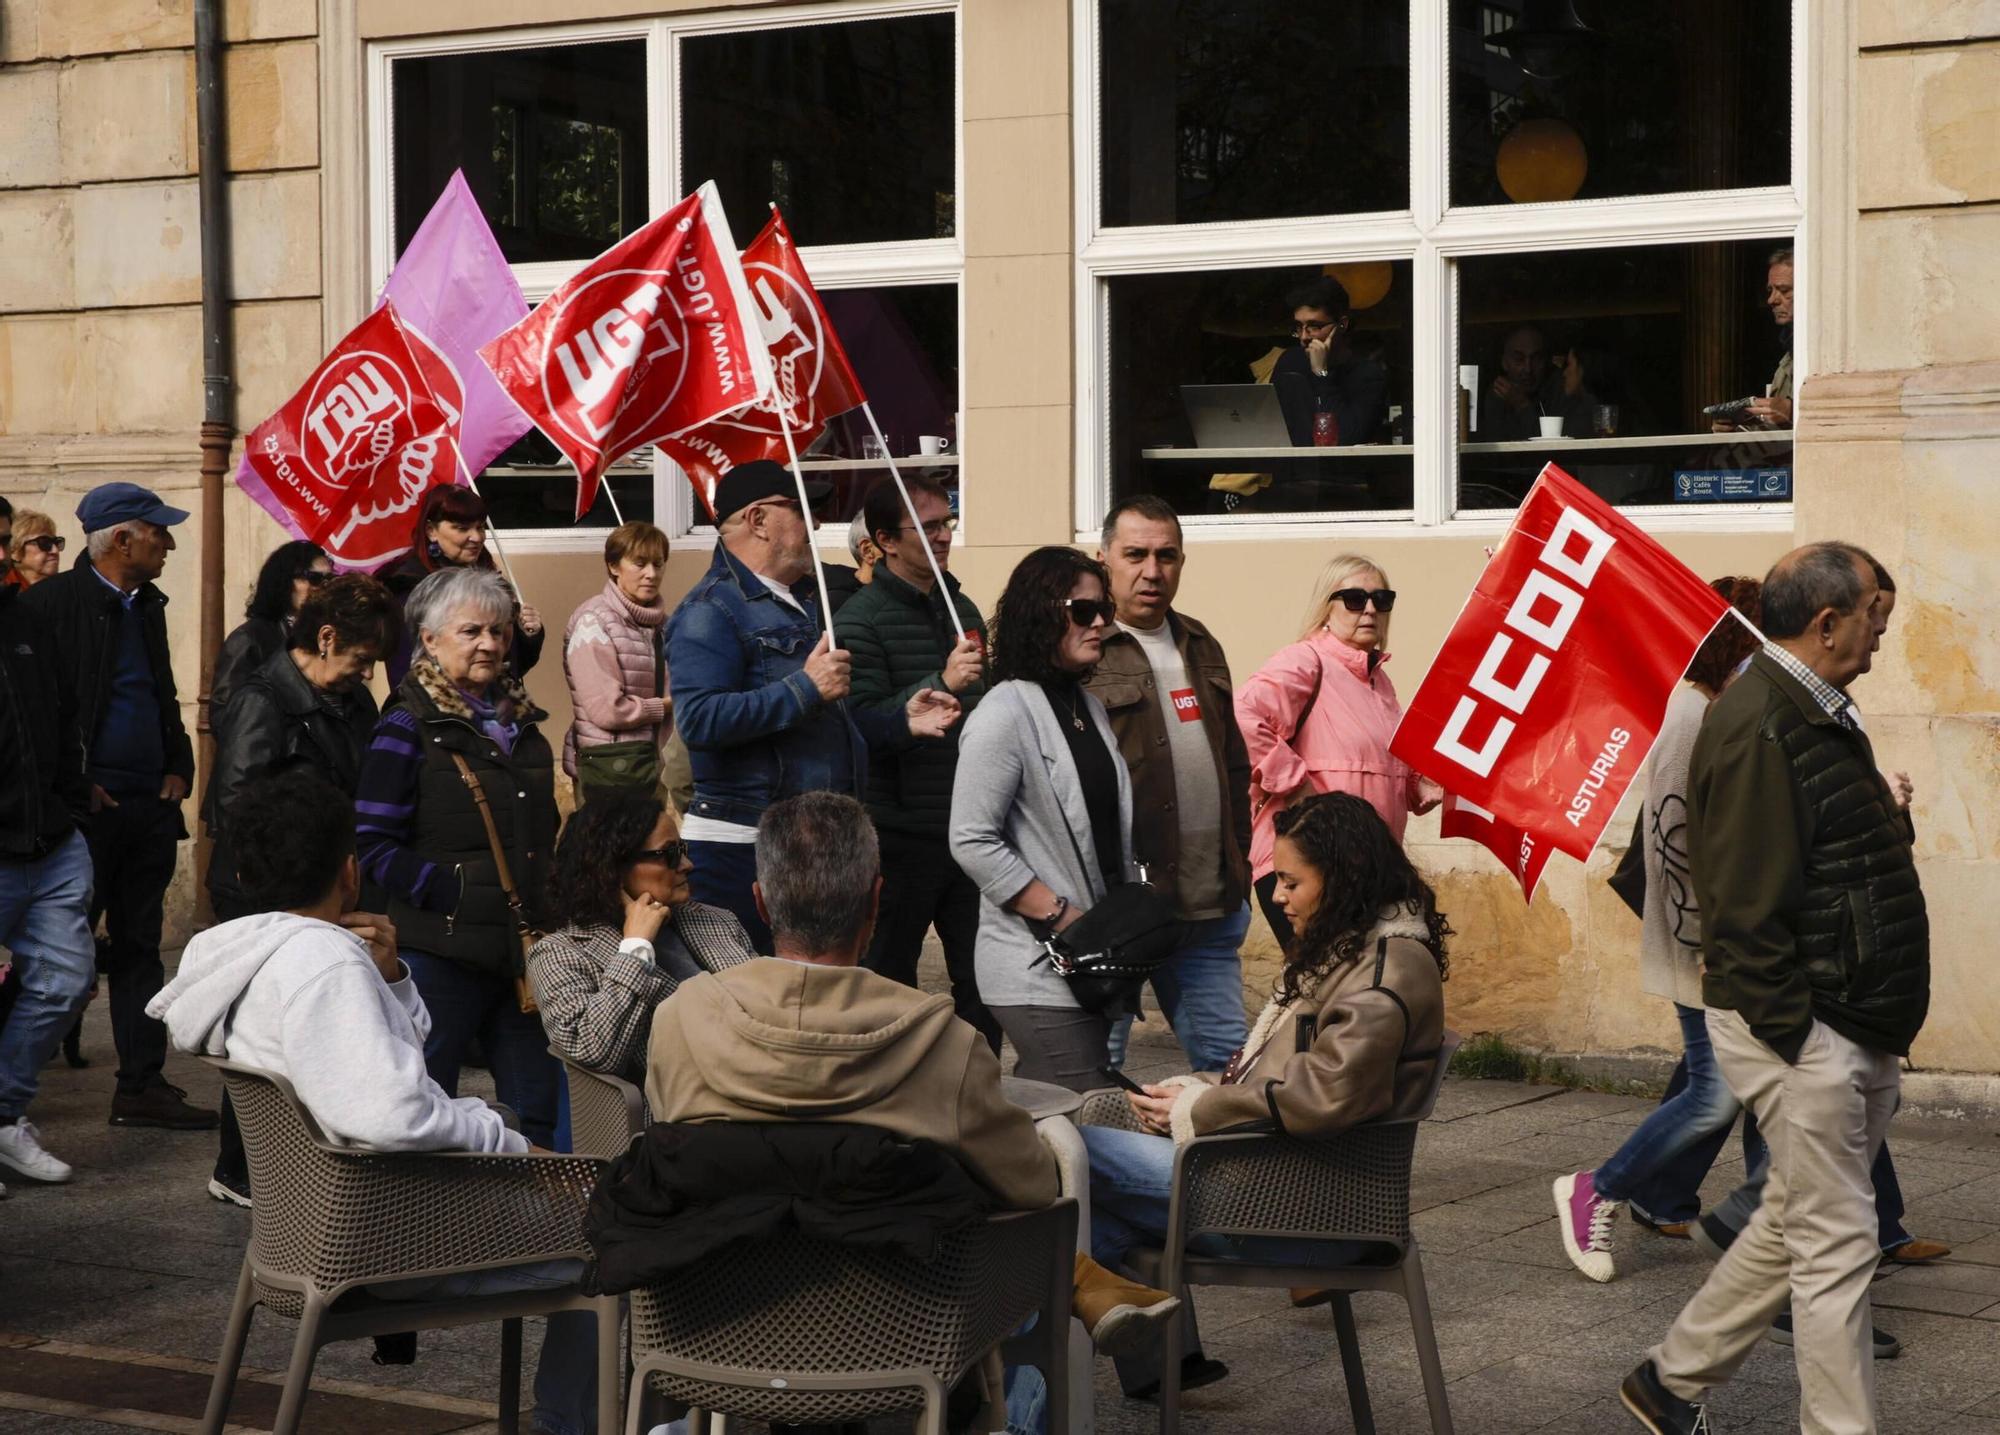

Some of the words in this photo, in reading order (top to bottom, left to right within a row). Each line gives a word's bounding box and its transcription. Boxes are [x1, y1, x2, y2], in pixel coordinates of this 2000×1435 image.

[554, 281, 663, 405] UGT
[1693, 474, 1720, 482] Historic
[1433, 505, 1618, 779] CCOO
[1174, 695, 1199, 710] UGT
[1564, 727, 1631, 828] ASTURIAS
